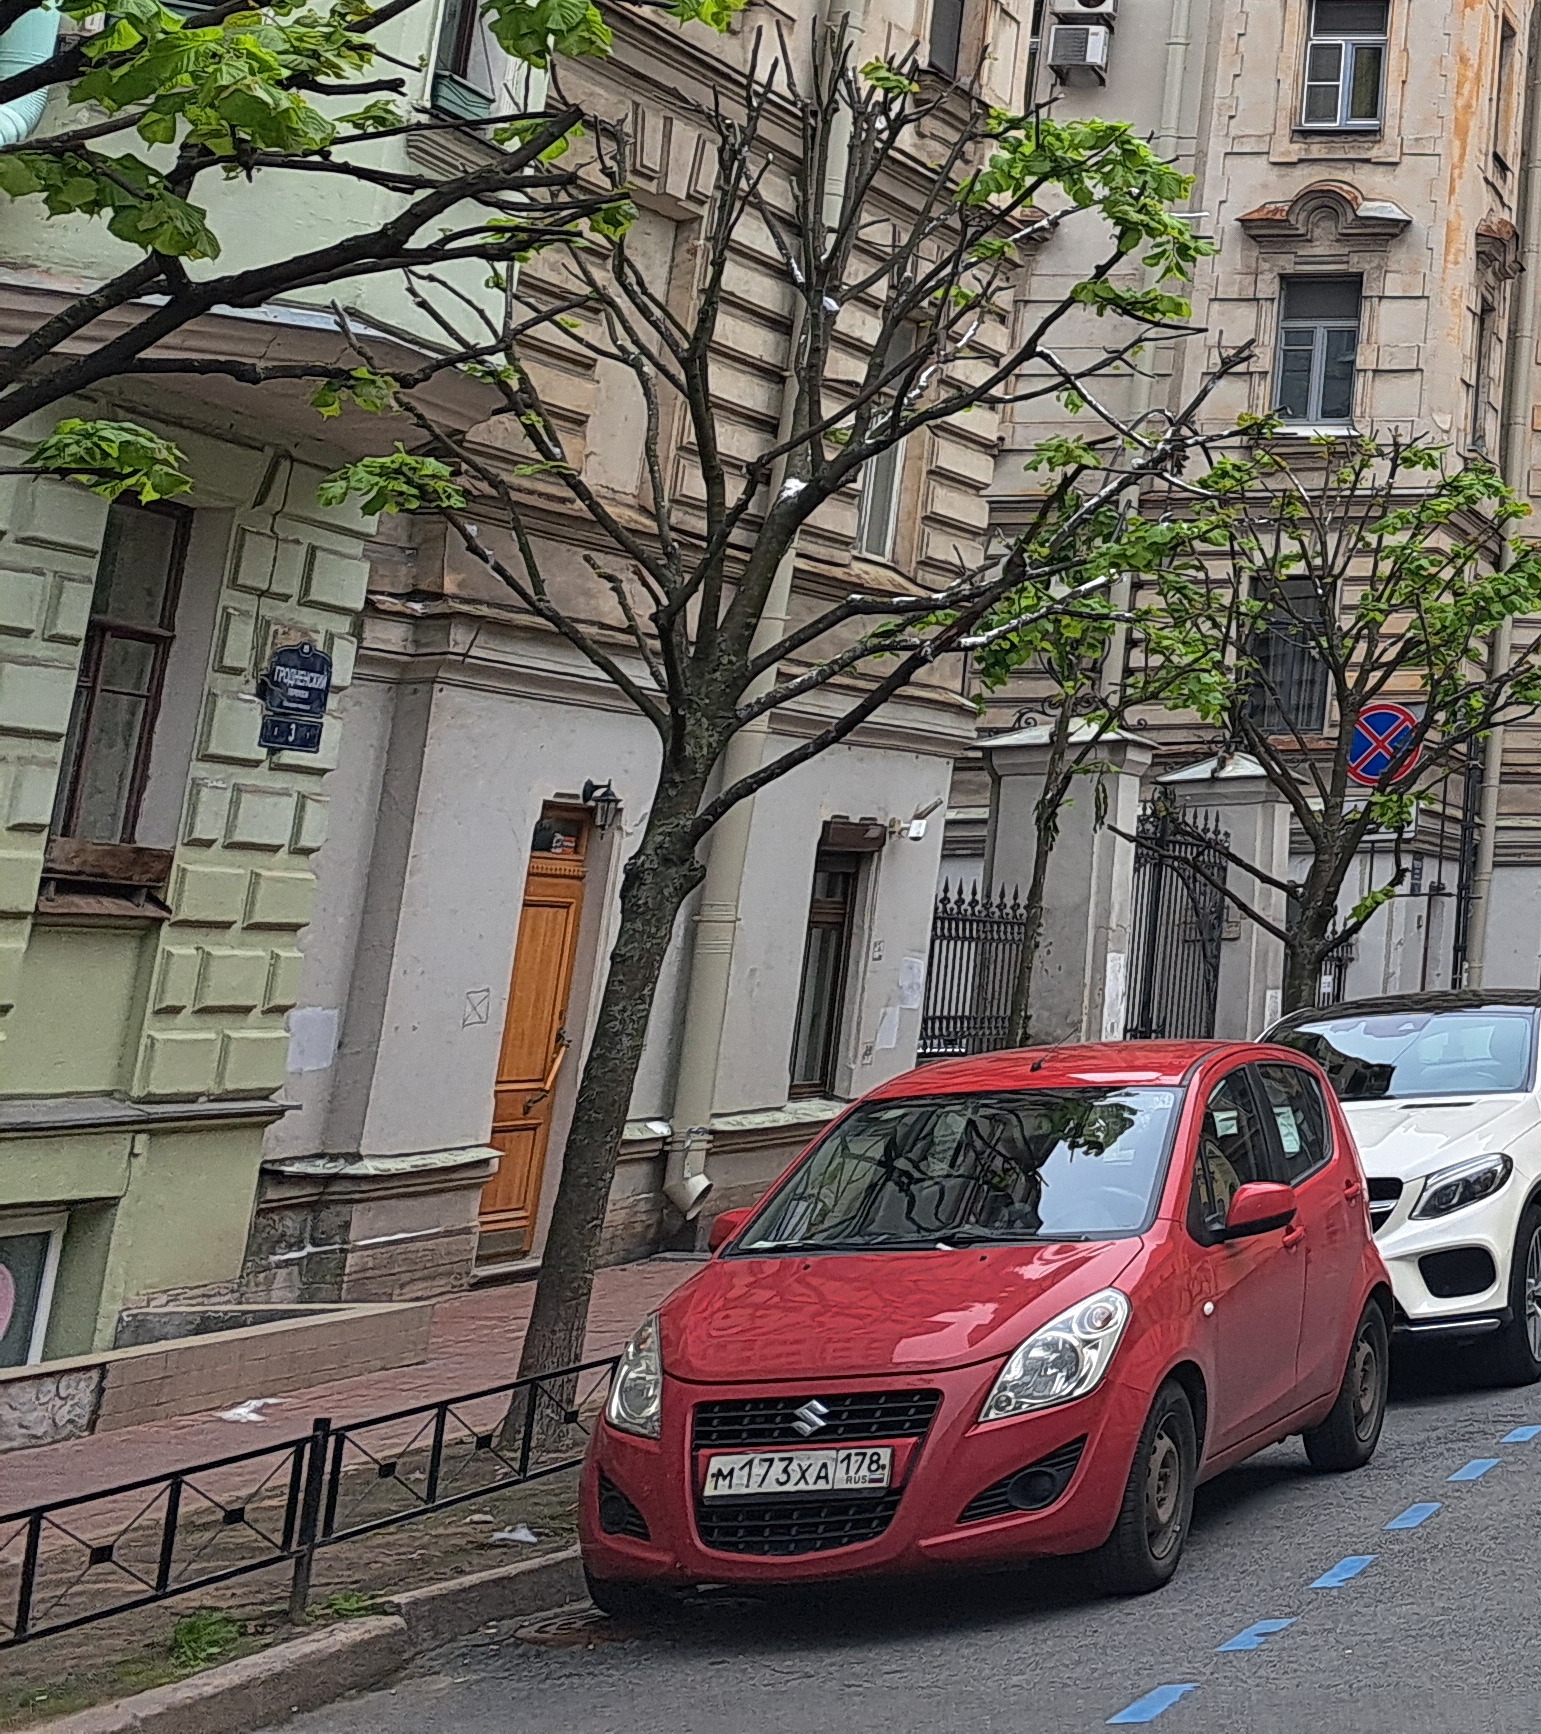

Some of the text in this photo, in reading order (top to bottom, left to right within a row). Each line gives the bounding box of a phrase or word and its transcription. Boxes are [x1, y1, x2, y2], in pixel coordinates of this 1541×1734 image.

[288, 723, 296, 742] 3
[713, 1452, 882, 1490] М173ХА 178
[845, 1474, 868, 1484] RUS
